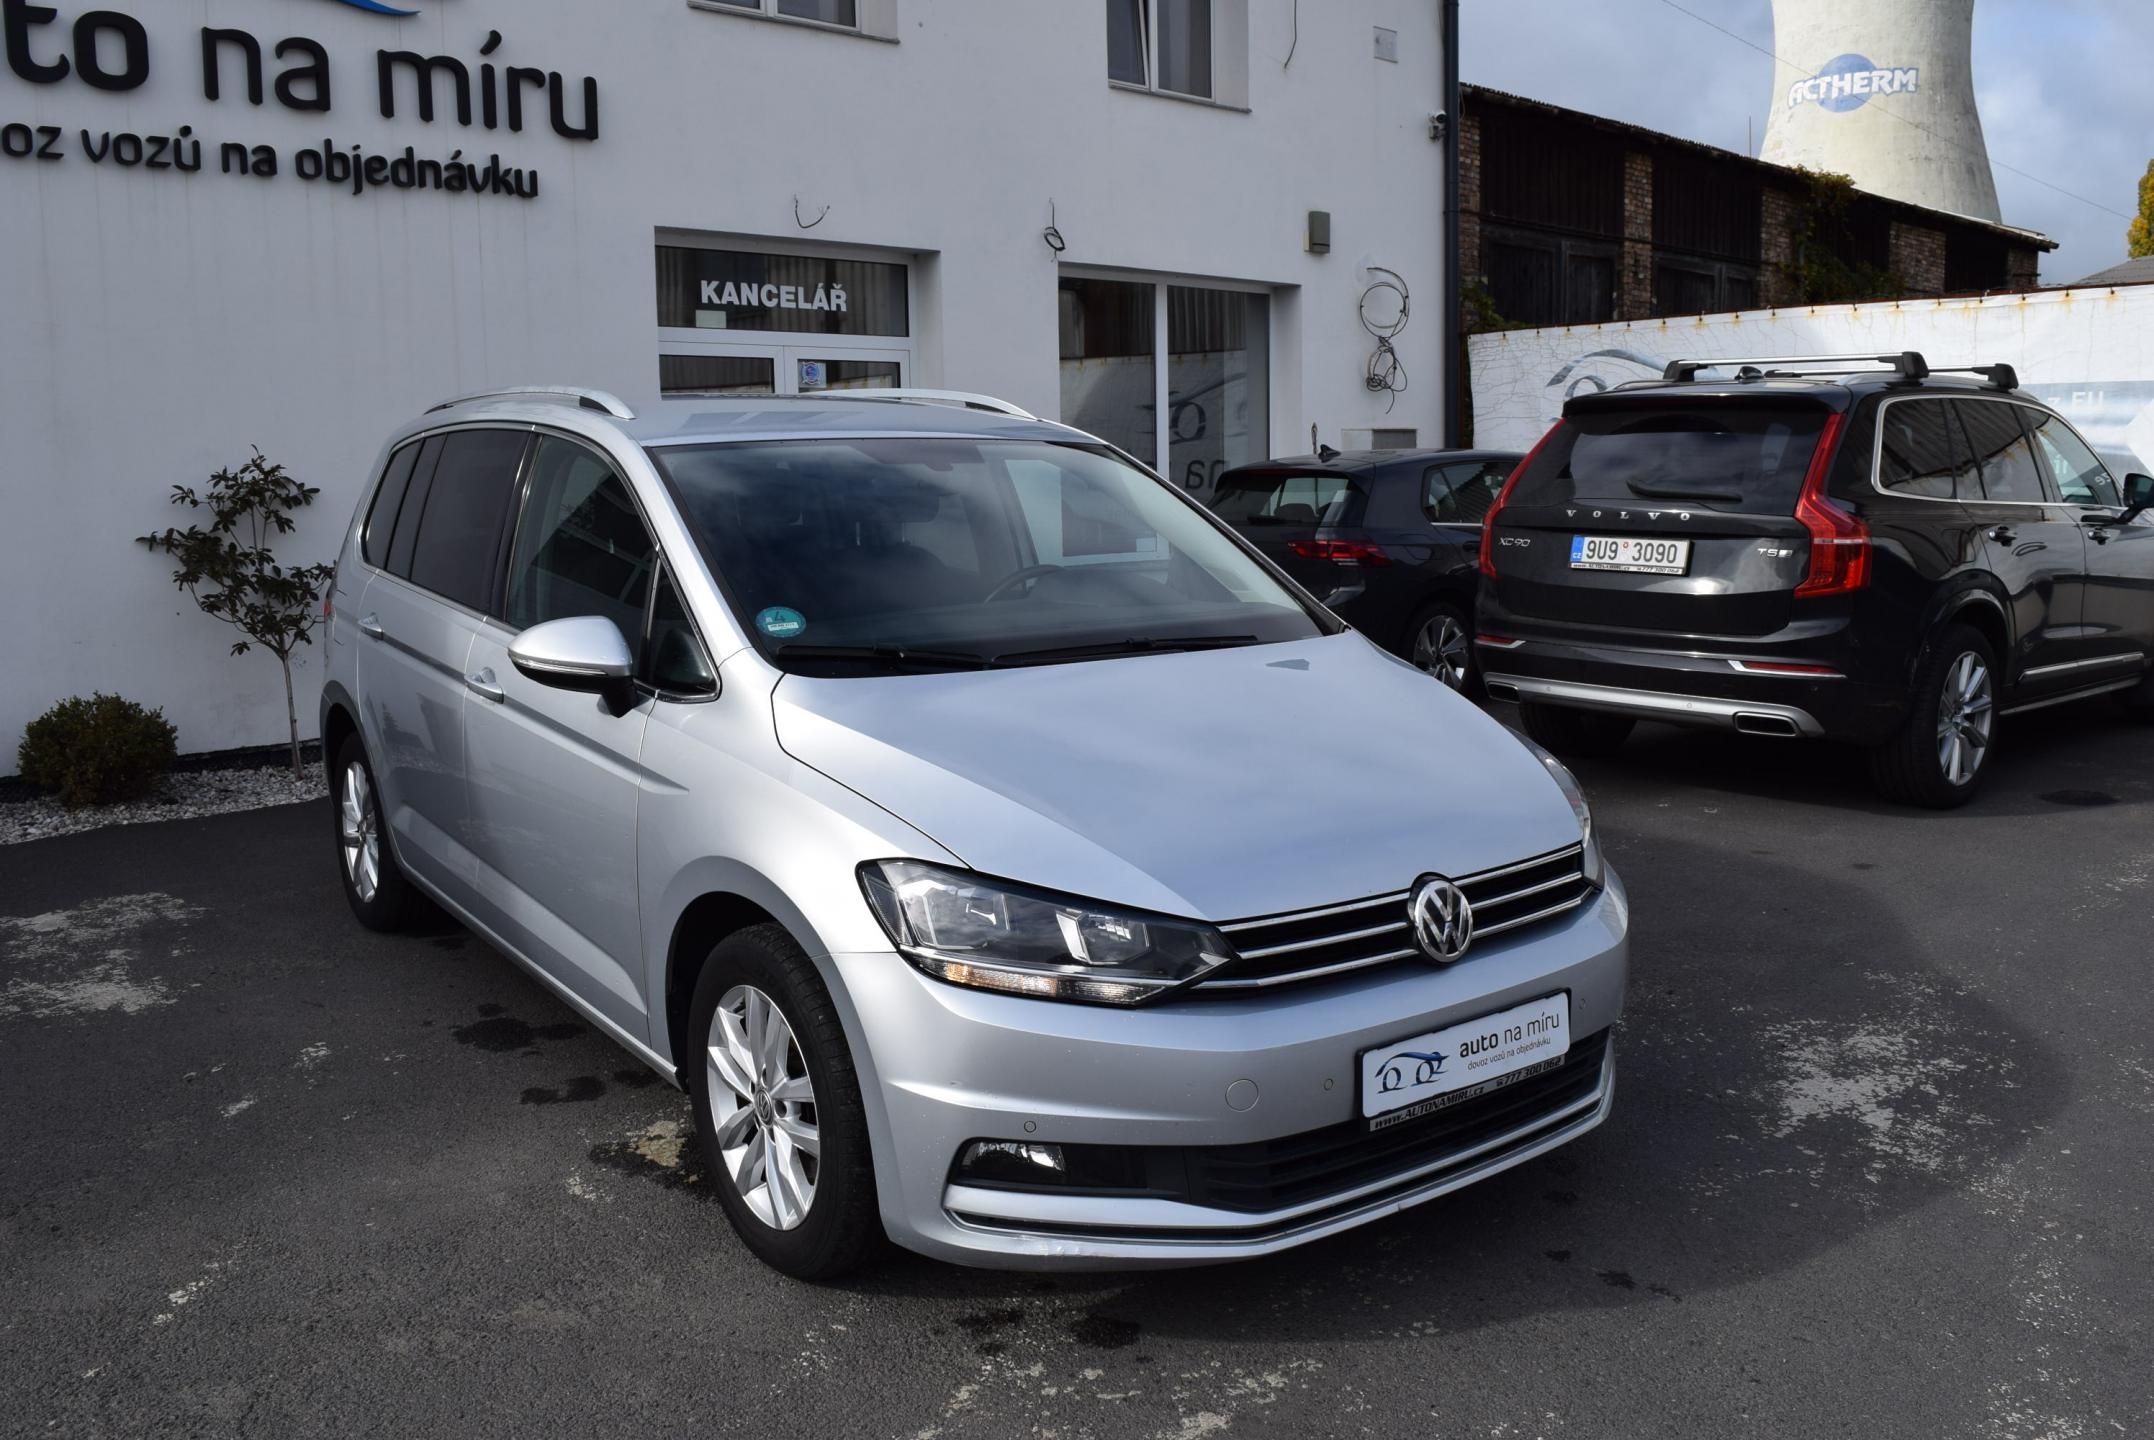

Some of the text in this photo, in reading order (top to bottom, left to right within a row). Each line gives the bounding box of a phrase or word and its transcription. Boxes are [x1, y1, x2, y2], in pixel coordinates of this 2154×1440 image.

[201, 25, 331, 112] na
[377, 29, 599, 141] míru
[1788, 67, 1919, 109] ACTHERM
[80, 125, 201, 172] vozů
[220, 140, 278, 177] na
[295, 138, 540, 199] objednávku
[700, 279, 847, 312] KANCELÁŘ
[1566, 509, 1690, 521] VOLVO
[1499, 537, 1531, 547] XC90
[1586, 540, 1678, 564] 9U9 3090
[1459, 1011, 1560, 1058] auto na míru
[1467, 1037, 1551, 1070] dovoz vozů na objednávku
